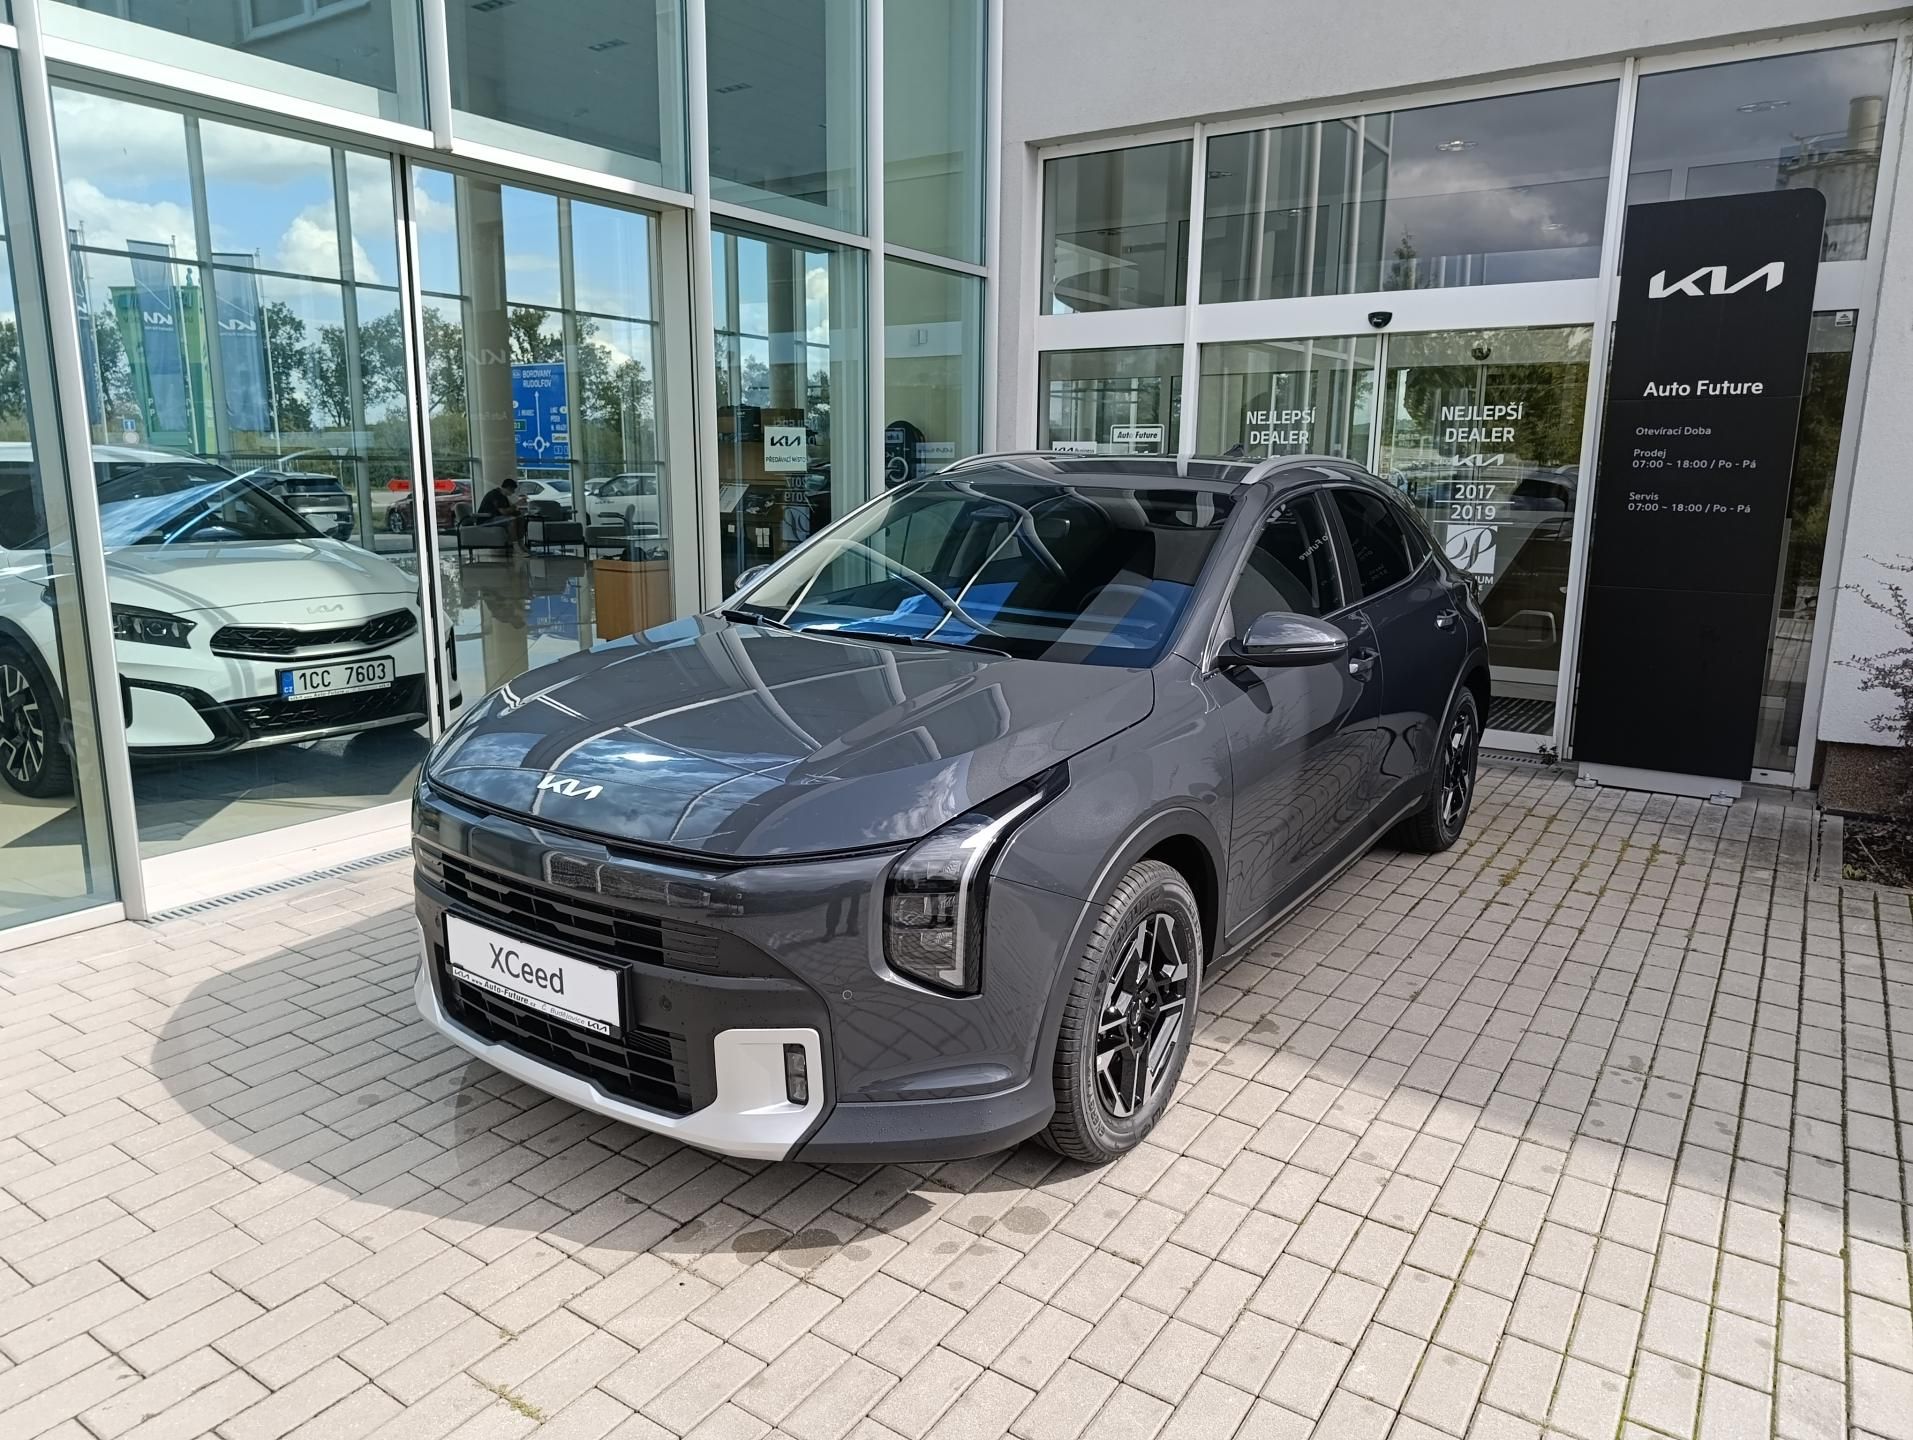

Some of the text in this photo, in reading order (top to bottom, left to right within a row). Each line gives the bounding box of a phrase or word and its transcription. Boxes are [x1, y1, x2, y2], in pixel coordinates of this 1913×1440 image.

[1649, 262, 1785, 299] KIA
[522, 369, 552, 378] BOROVANY
[523, 379, 552, 388] RUDOLFOV
[1643, 380, 1764, 397] Auto Future
[1247, 407, 1316, 424] NEJLEPŠÍ
[1441, 402, 1524, 421] NEJLEPŠÍ
[1135, 431, 1159, 439] Future
[1250, 431, 1309, 445] DEALER
[1445, 428, 1515, 443] DEALER
[1636, 427, 1712, 436] Otevírací Doba
[770, 435, 801, 447] KIA
[1452, 454, 1505, 467] KIA
[1633, 449, 1667, 459] Prodej
[1632, 460, 1663, 468] 07:00
[1676, 460, 1708, 468] 18:00
[1718, 460, 1733, 468] Po
[1742, 460, 1757, 468] Pá
[1454, 484, 1496, 499] 2017
[1629, 492, 1659, 500] Servis
[1450, 504, 1496, 520] 2019
[1628, 503, 1659, 511] 07:00
[1672, 504, 1702, 512] 18:00
[1713, 504, 1727, 512] Po
[1737, 504, 1751, 513] Pá
[306, 604, 343, 614] KIA
[299, 670, 331, 691] 1CC
[345, 663, 386, 685] 7603
[537, 775, 604, 800] KIA
[489, 942, 565, 995] XCeed
[454, 969, 470, 980] KIA
[587, 1021, 607, 1032] KIA
